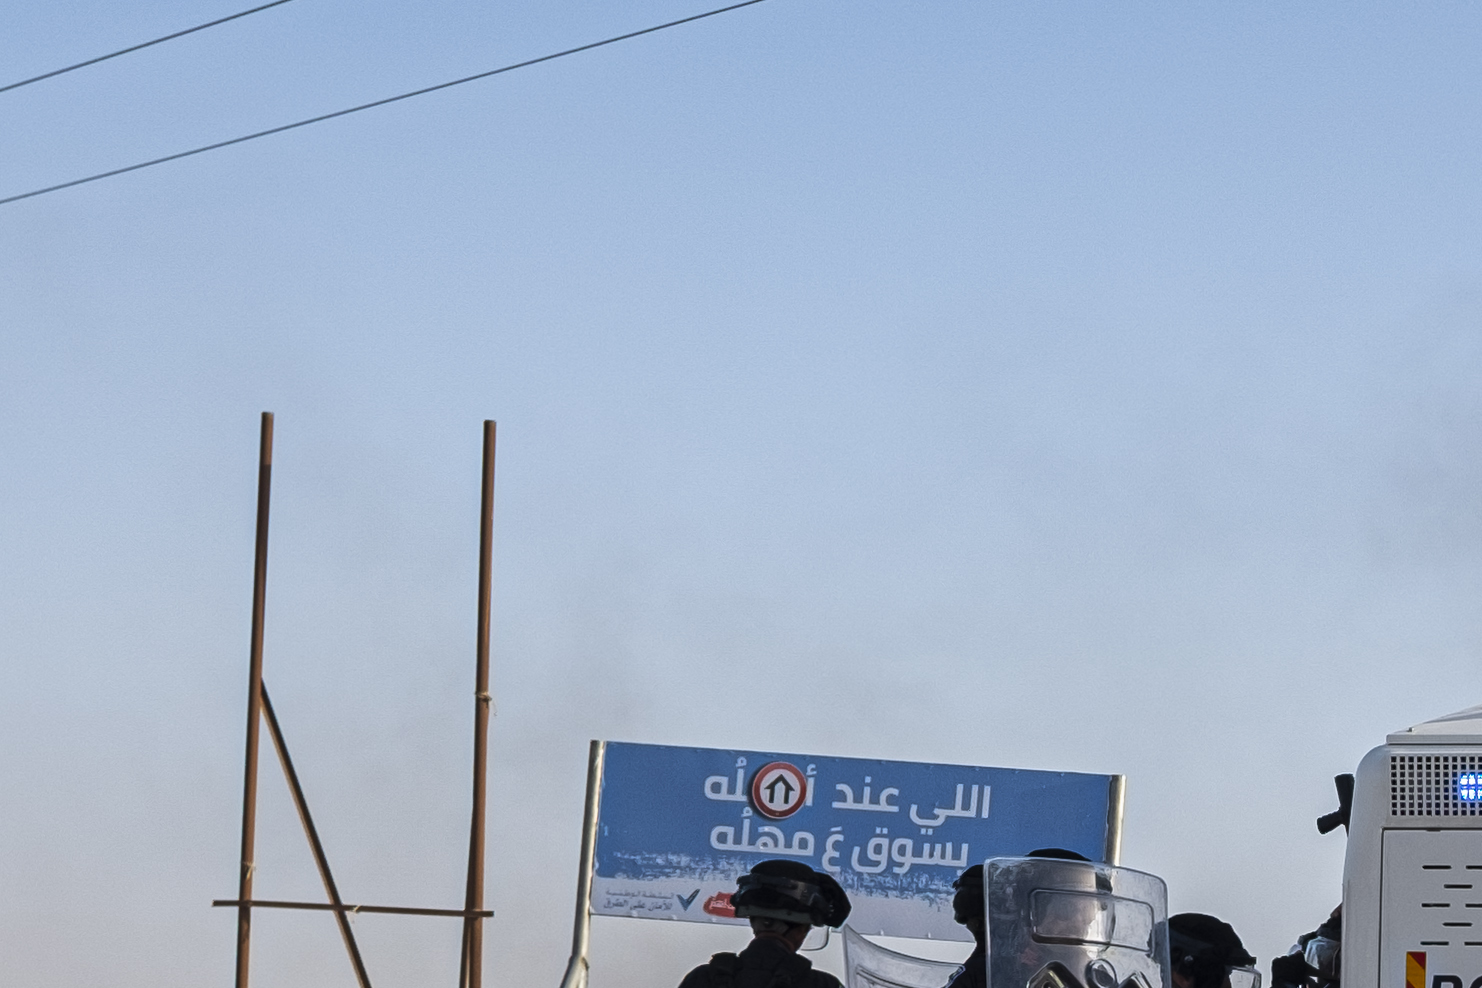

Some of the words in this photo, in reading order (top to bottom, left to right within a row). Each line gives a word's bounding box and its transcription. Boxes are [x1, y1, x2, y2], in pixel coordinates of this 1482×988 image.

[831, 776, 899, 813] عند
[909, 783, 991, 835] اللي
[851, 826, 969, 876] بسوق
